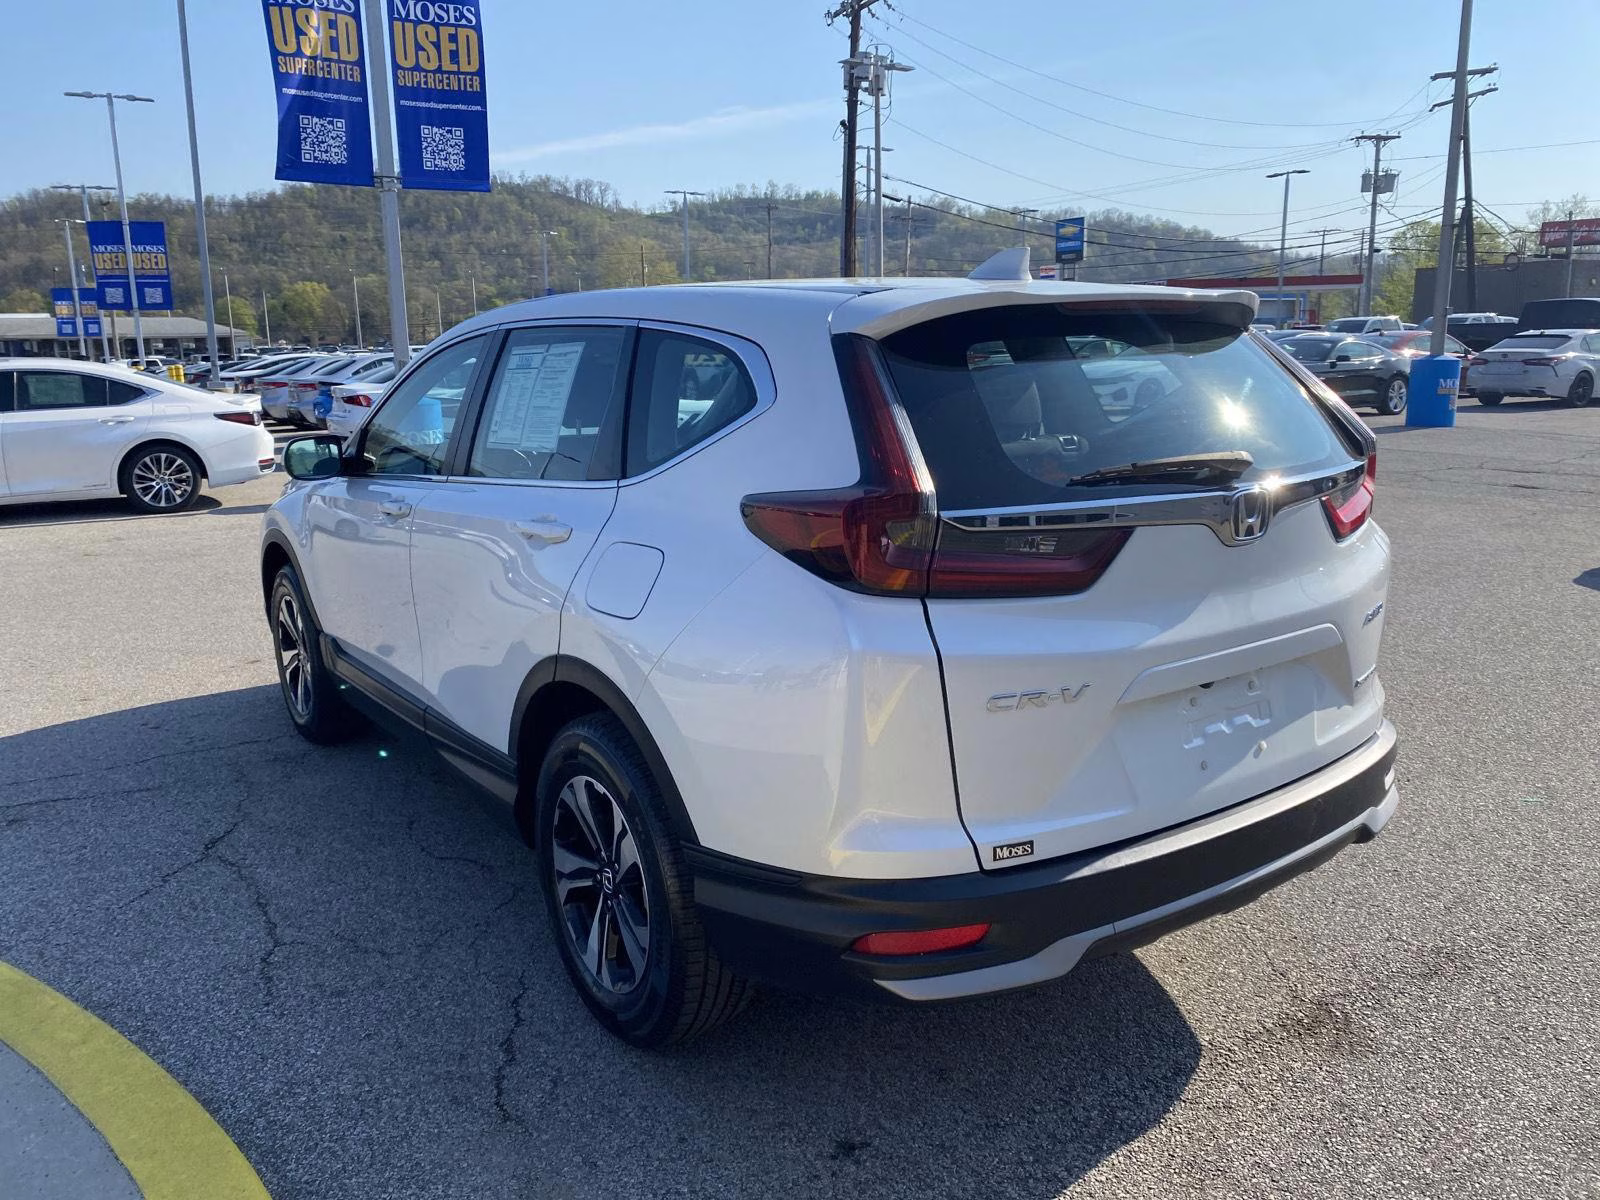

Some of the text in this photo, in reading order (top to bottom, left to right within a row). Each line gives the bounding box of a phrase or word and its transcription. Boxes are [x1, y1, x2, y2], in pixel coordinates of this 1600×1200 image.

[393, 0, 477, 26] MOSES
[268, 6, 360, 62] USED
[393, 20, 480, 73] USED
[277, 56, 361, 82] SUPERCENTER
[397, 69, 481, 92] SUPERCENTER
[400, 99, 482, 111] mosesusedsupercenter.com
[92, 244, 125, 253] MOSES
[132, 244, 165, 253] MOSES
[94, 252, 127, 269] USED
[132, 252, 167, 269] USED
[986, 682, 1094, 713] CR-V
[994, 844, 1032, 860] MOSES
